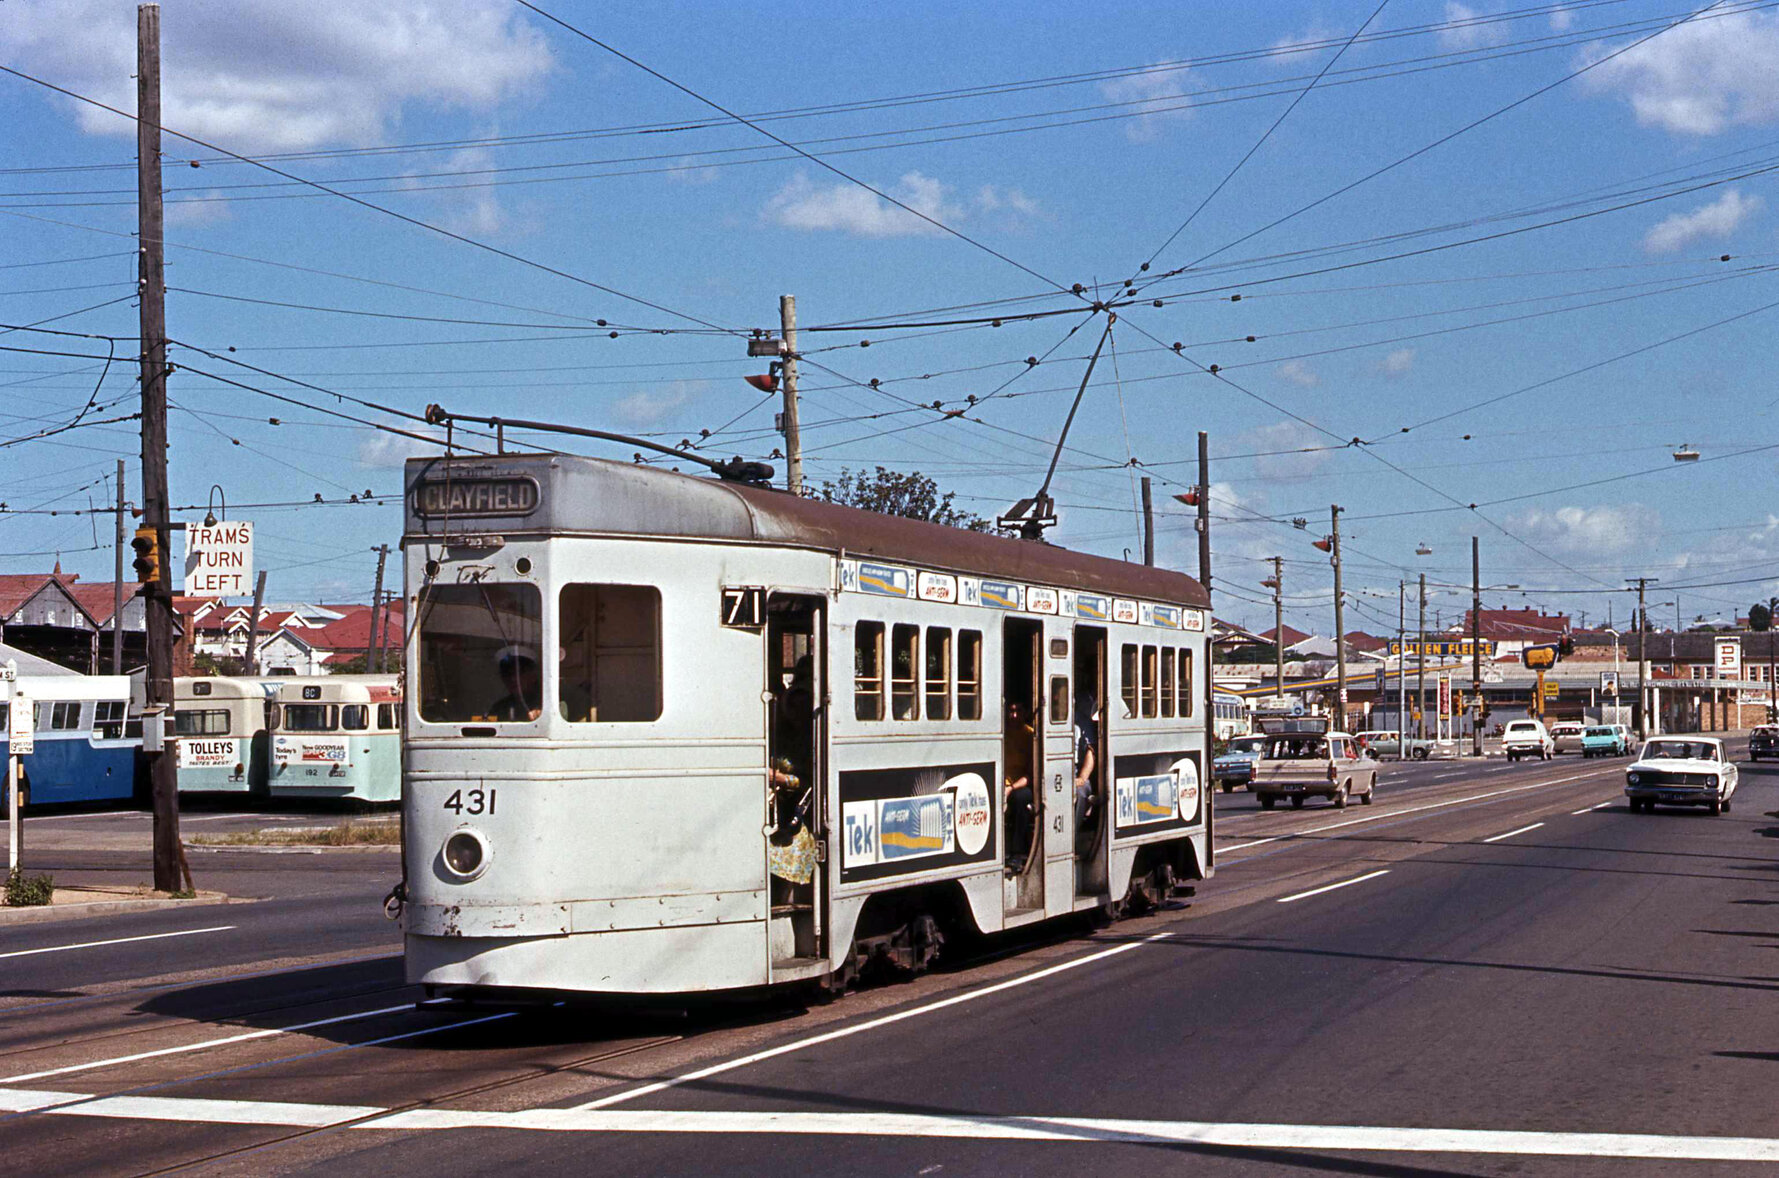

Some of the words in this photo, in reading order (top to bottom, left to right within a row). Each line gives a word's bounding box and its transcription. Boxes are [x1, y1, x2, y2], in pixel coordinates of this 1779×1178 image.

[424, 482, 532, 511] CLAYFIELD
[189, 528, 250, 545] TRAMS
[194, 551, 243, 568] TURN
[194, 574, 243, 591] LEFT
[964, 580, 977, 602] Tek
[725, 591, 759, 624] 71
[189, 741, 233, 755] TOLLEYS
[275, 747, 297, 755] Today's
[314, 744, 345, 752] GOODYEAR
[443, 788, 496, 816] 431
[1117, 787, 1133, 819] Tek
[958, 811, 988, 828] ANTI-GERM
[1053, 815, 1064, 833] 431
[845, 813, 873, 856] Tek
